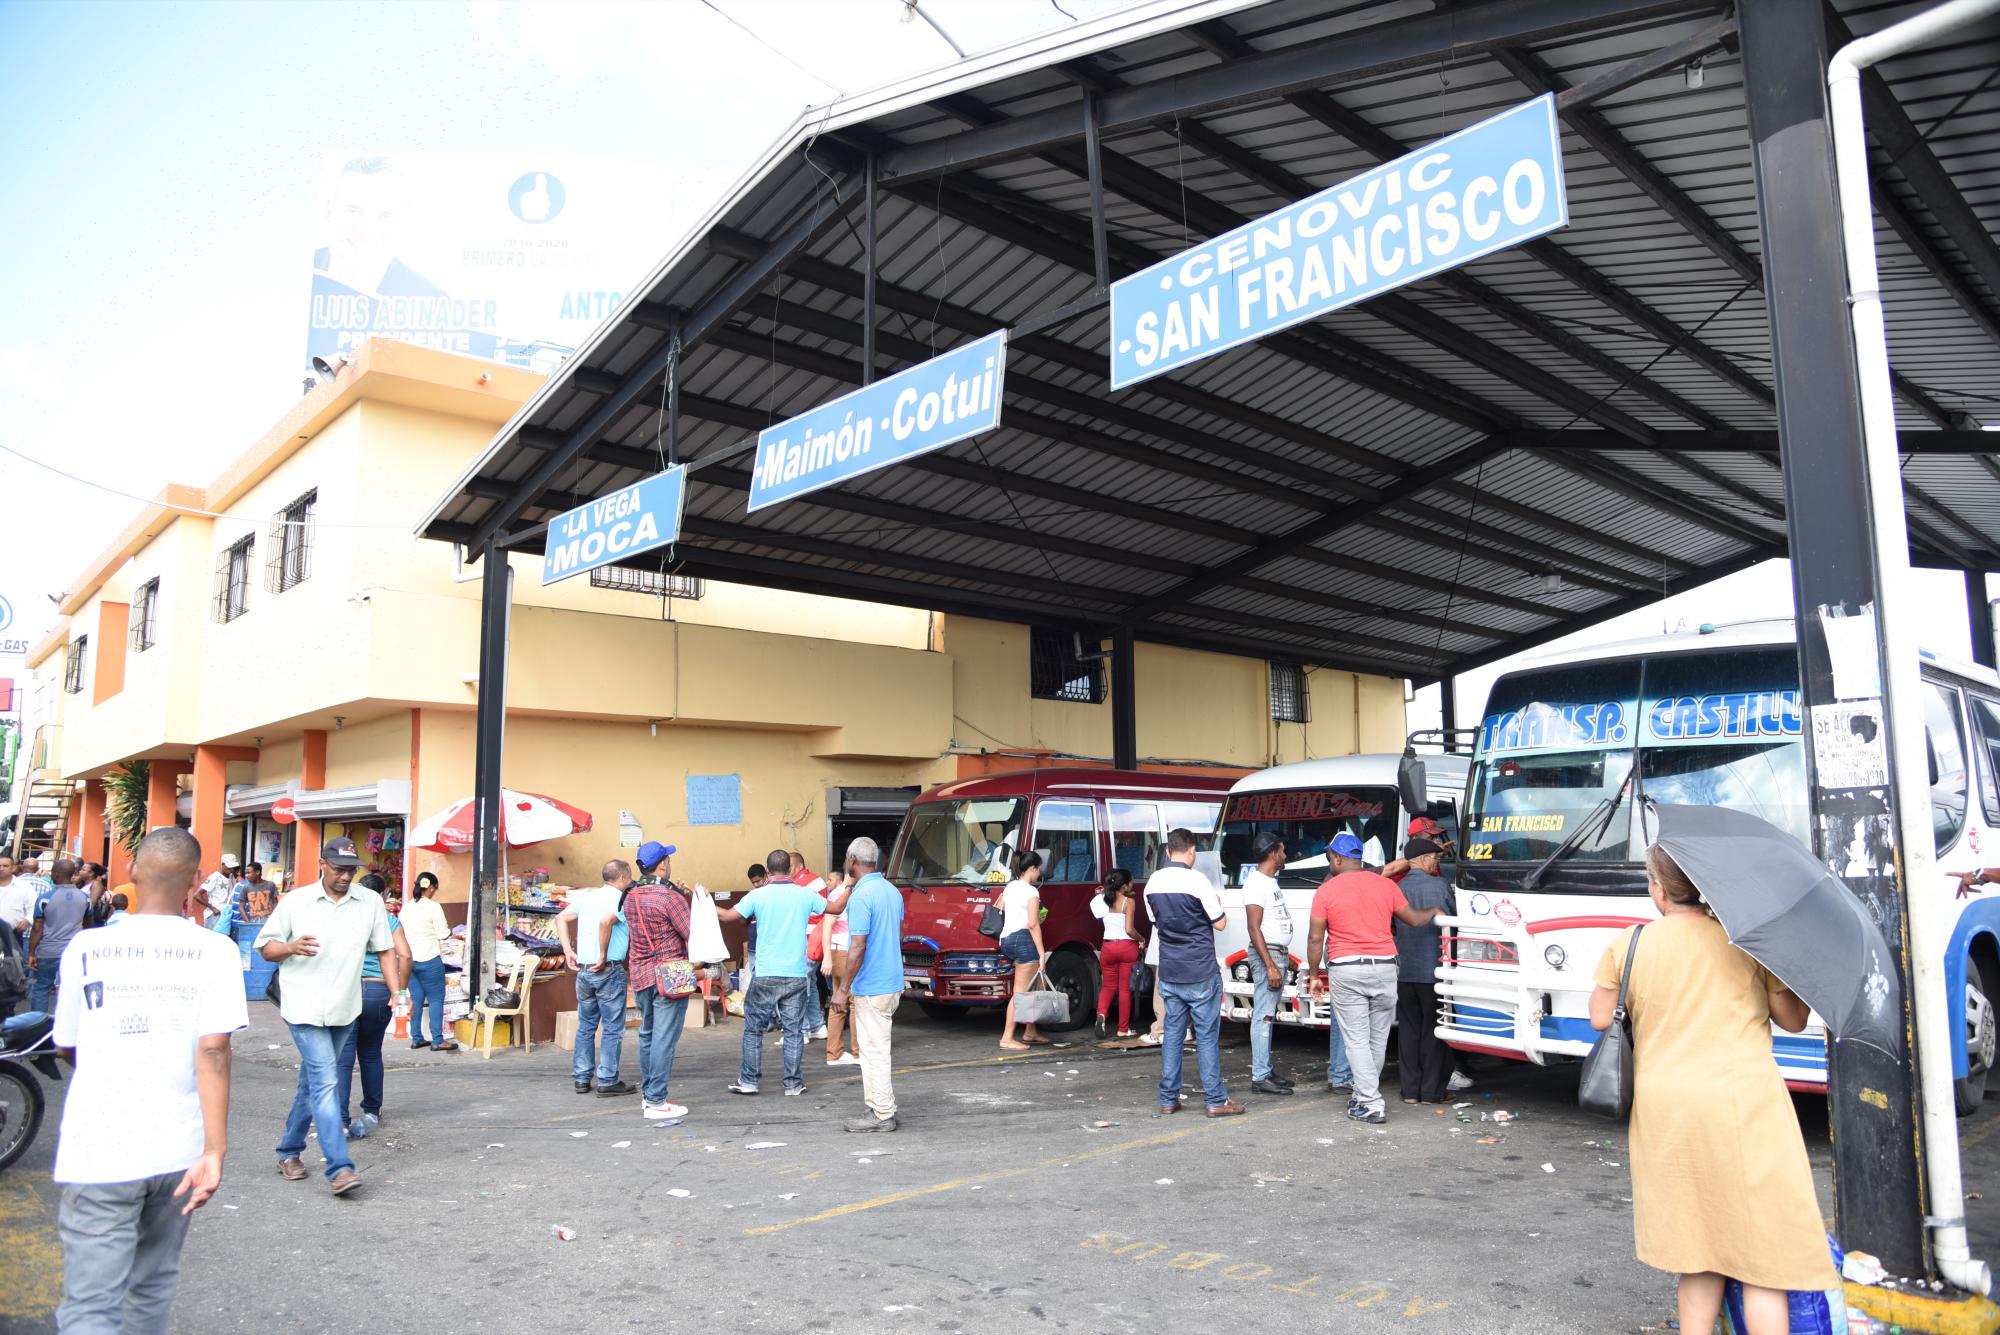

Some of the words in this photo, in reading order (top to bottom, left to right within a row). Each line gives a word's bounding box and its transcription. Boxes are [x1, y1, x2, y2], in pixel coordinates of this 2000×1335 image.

[1179, 152, 1454, 288] CENOVIC
[464, 250, 526, 268] PRIMERO
[1135, 286, 1220, 367] SAN
[1237, 158, 1545, 329] FRANCISCO
[313, 295, 369, 328] LUIS
[374, 296, 497, 329] ABINADER
[760, 410, 874, 491] Maimón
[893, 356, 995, 441] Cotui
[566, 508, 590, 539] LA
[593, 488, 641, 527] VEGA
[552, 511, 660, 575] MOCA
[1481, 700, 1629, 754] TRANSP.
[1649, 690, 1805, 740] CASTILL
[1481, 816, 1504, 832] SAN
[1505, 815, 1564, 832] FRANCISCO
[1467, 843, 1493, 860] 422
[247, 890, 270, 902] EAT
[92, 946, 145, 960] NORTH
